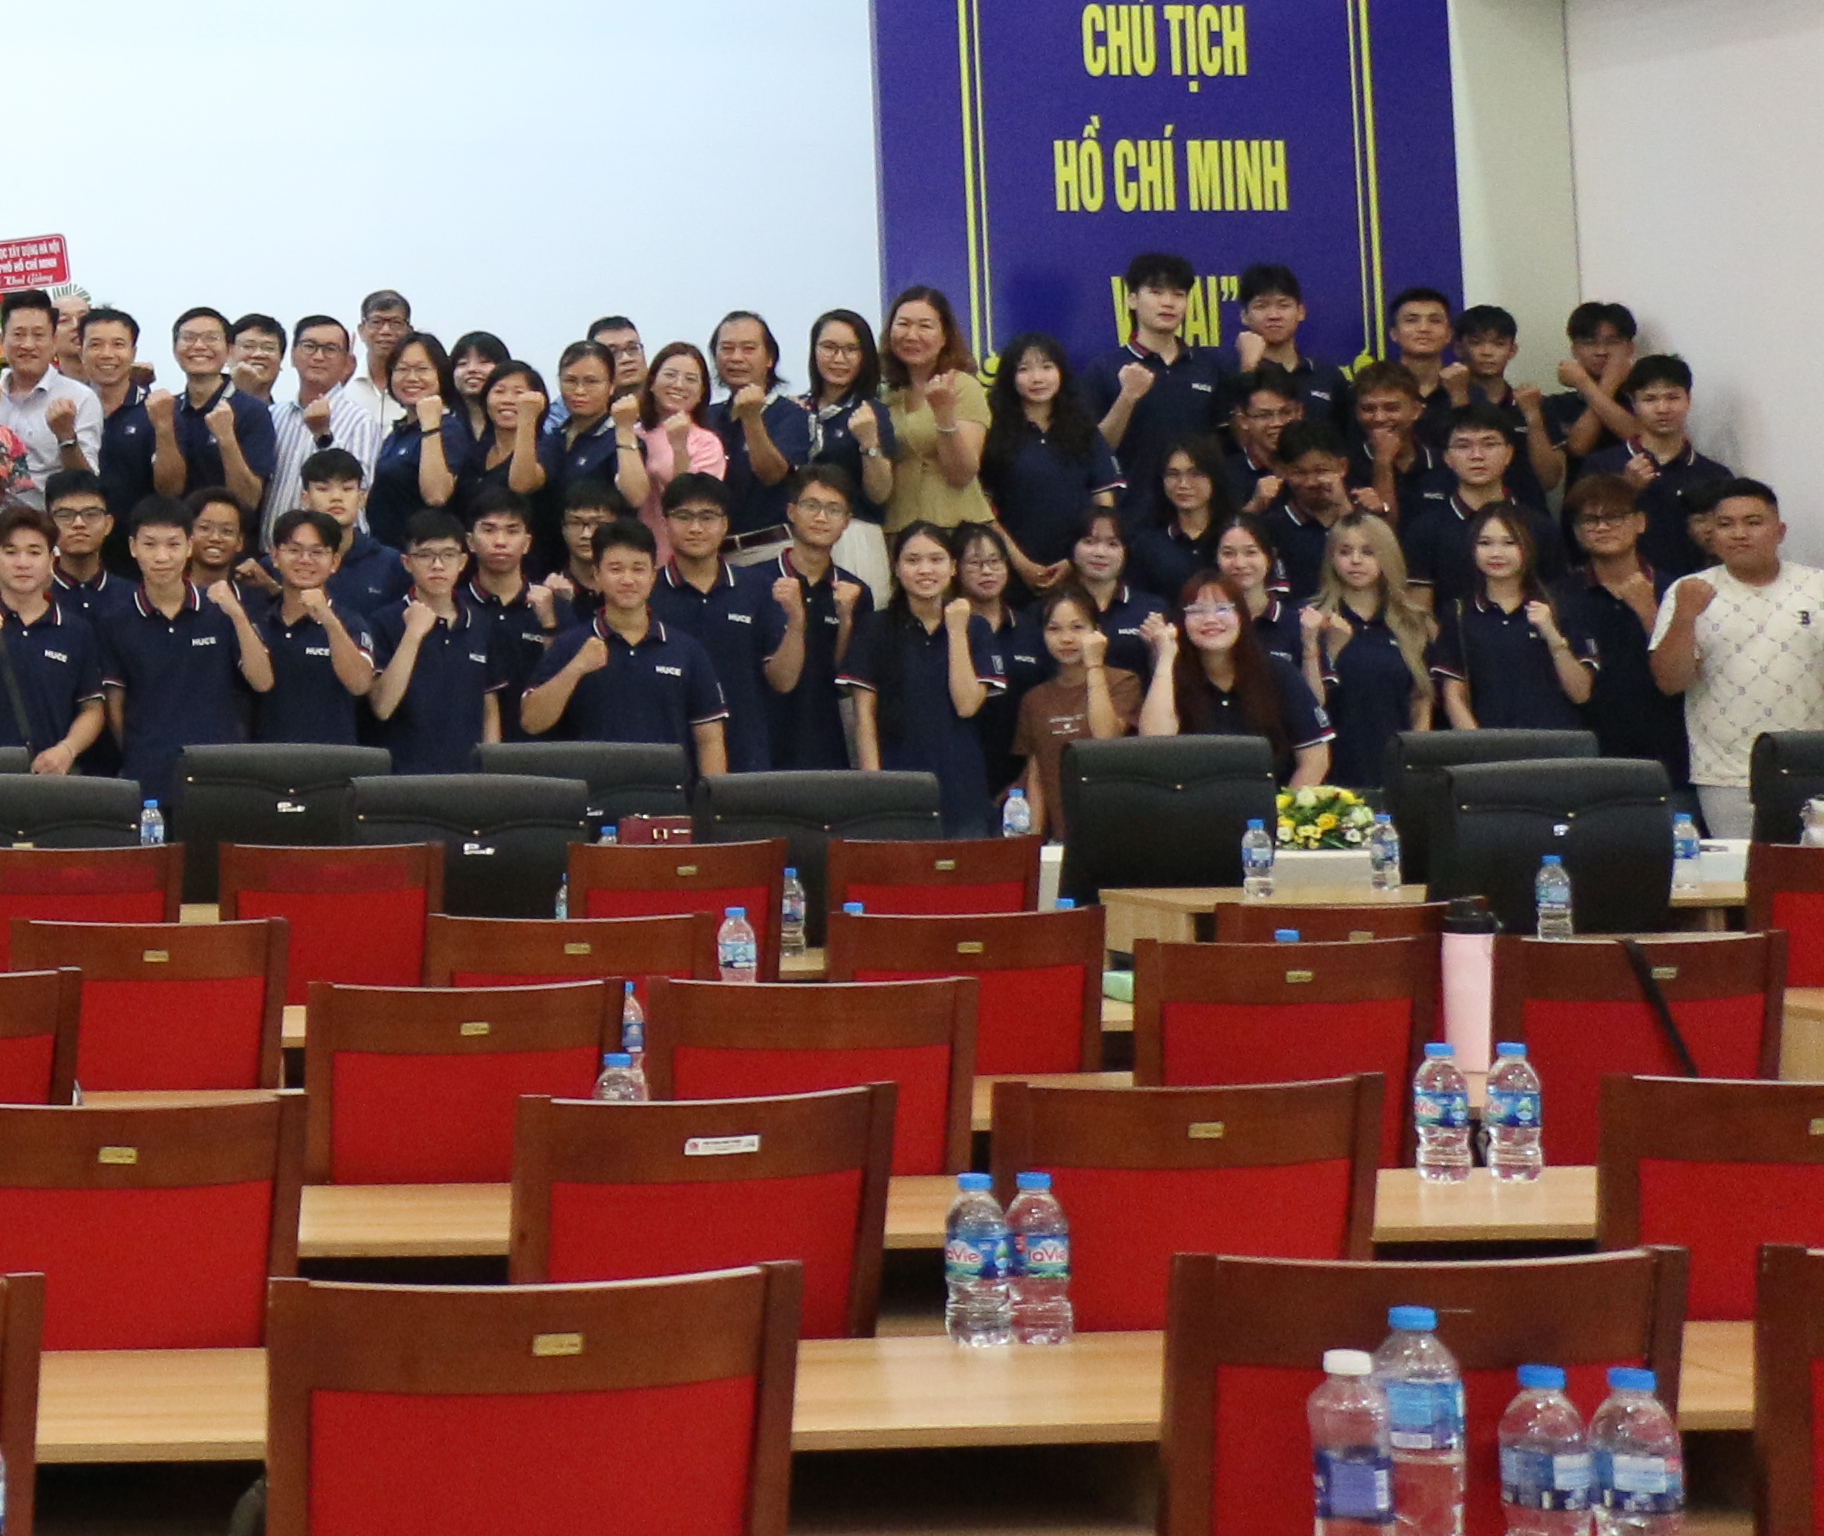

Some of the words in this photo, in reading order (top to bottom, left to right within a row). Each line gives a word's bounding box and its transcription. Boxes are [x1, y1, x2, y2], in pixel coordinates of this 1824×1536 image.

[1164, 4, 1248, 92] TỊCH
[1054, 116, 1105, 212] HỒ
[1114, 125, 1176, 212] CHÍ
[1187, 140, 1289, 210] MINH
[44, 649, 68, 662] HUCE
[192, 636, 216, 646] HUCE
